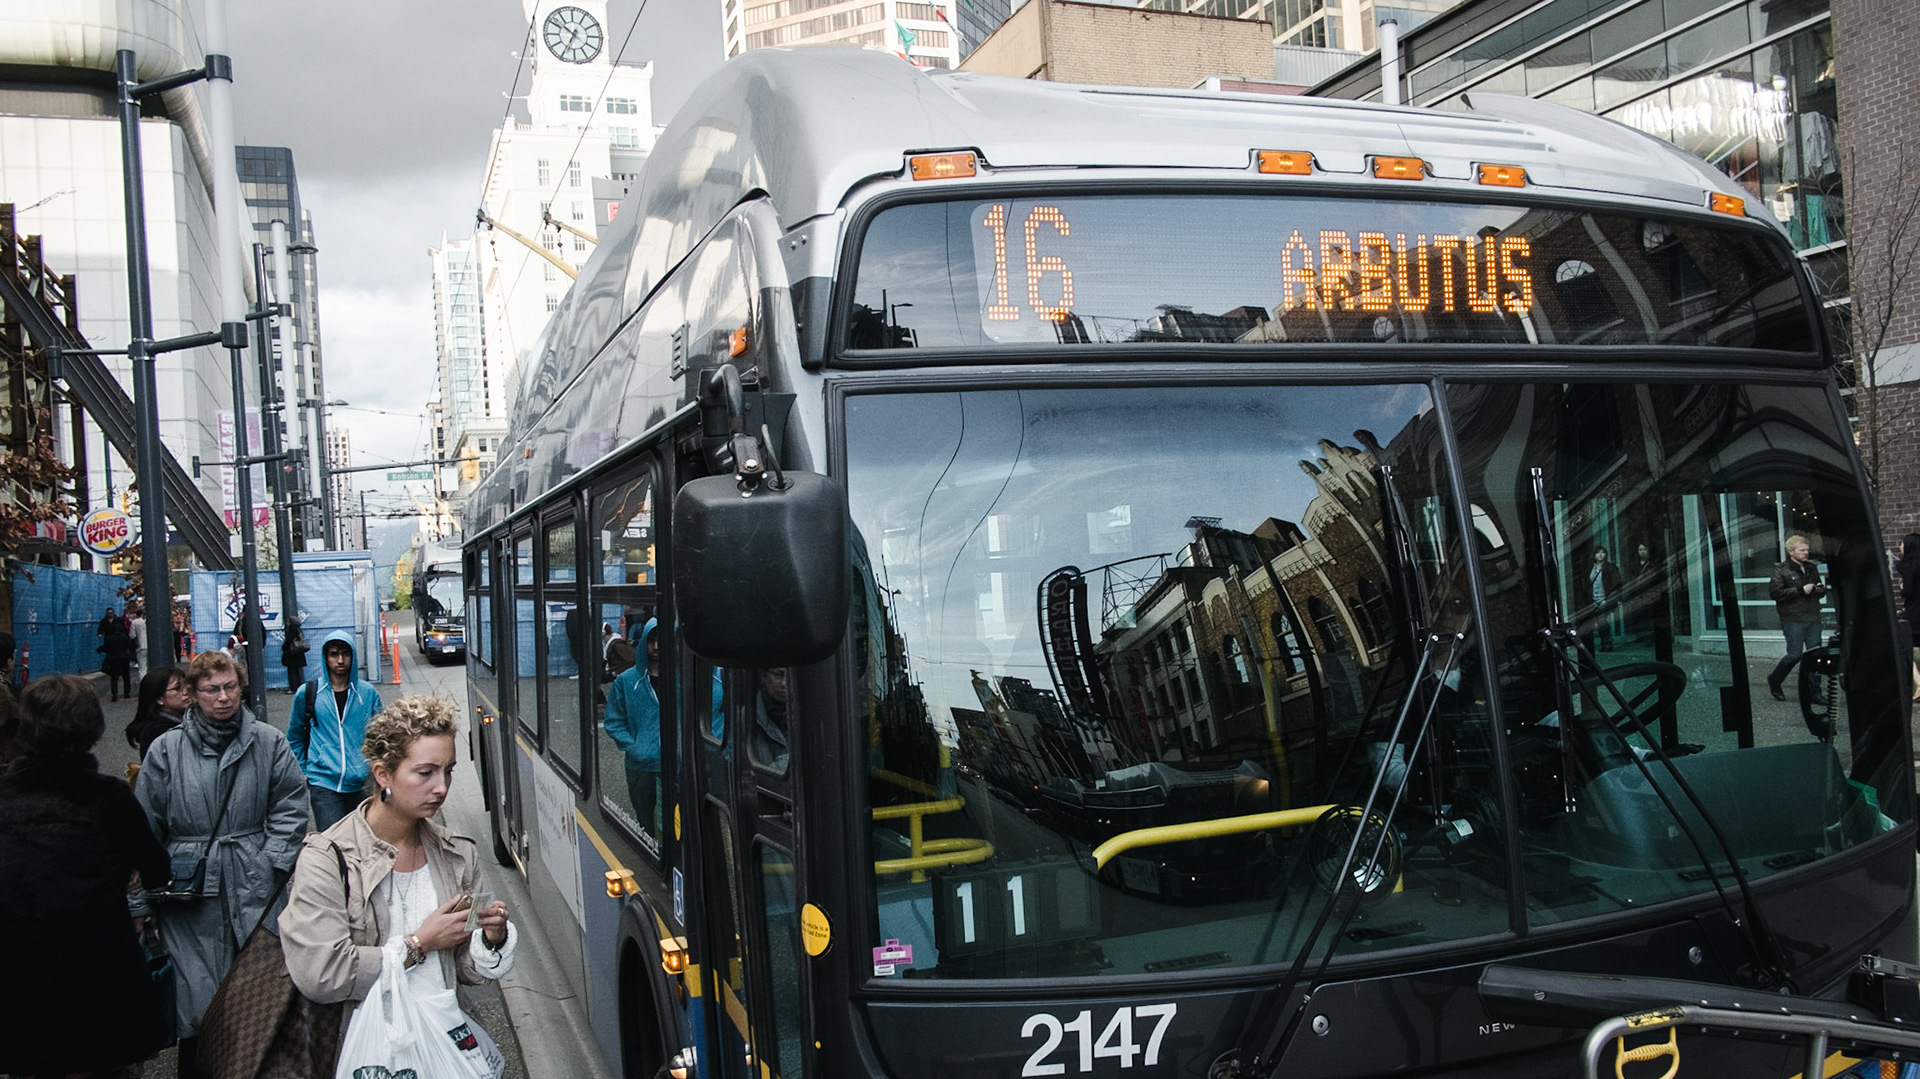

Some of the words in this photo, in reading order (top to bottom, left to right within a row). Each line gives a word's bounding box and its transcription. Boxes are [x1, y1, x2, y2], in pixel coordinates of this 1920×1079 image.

[983, 204, 1075, 321] 16
[1281, 229, 1533, 313] ARBUTUS
[392, 472, 419, 480] Robson
[421, 471, 428, 479] St
[86, 517, 126, 533] BURGER
[87, 525, 128, 545] KING
[1021, 1003, 1177, 1078] 2147
